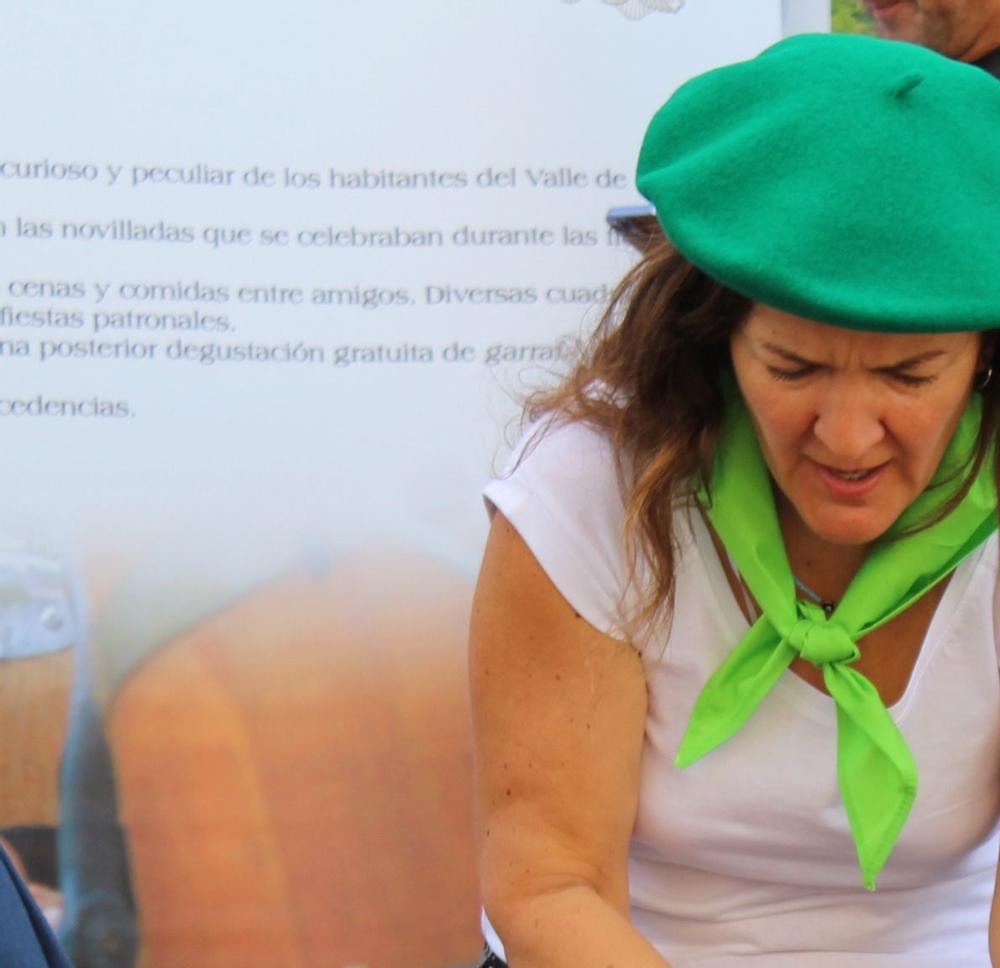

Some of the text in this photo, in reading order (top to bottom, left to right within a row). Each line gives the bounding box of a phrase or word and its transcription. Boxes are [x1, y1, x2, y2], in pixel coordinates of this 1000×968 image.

[0, 159, 627, 189] curioso y peculiar de los habitantes del Valle de
[16, 217, 53, 239] las
[62, 219, 195, 243] novilladas
[203, 225, 252, 248] que
[259, 227, 289, 246] se
[297, 226, 443, 247] celebraban
[452, 225, 554, 246] durante
[563, 225, 598, 246] las
[8, 279, 611, 309] cenas y comidas entre amigos. Diversas cuad
[0, 306, 237, 333] fiestas patronales.
[40, 338, 158, 361] posterior
[165, 340, 325, 365] degustación
[333, 342, 434, 367] gratuita
[442, 342, 476, 362] de
